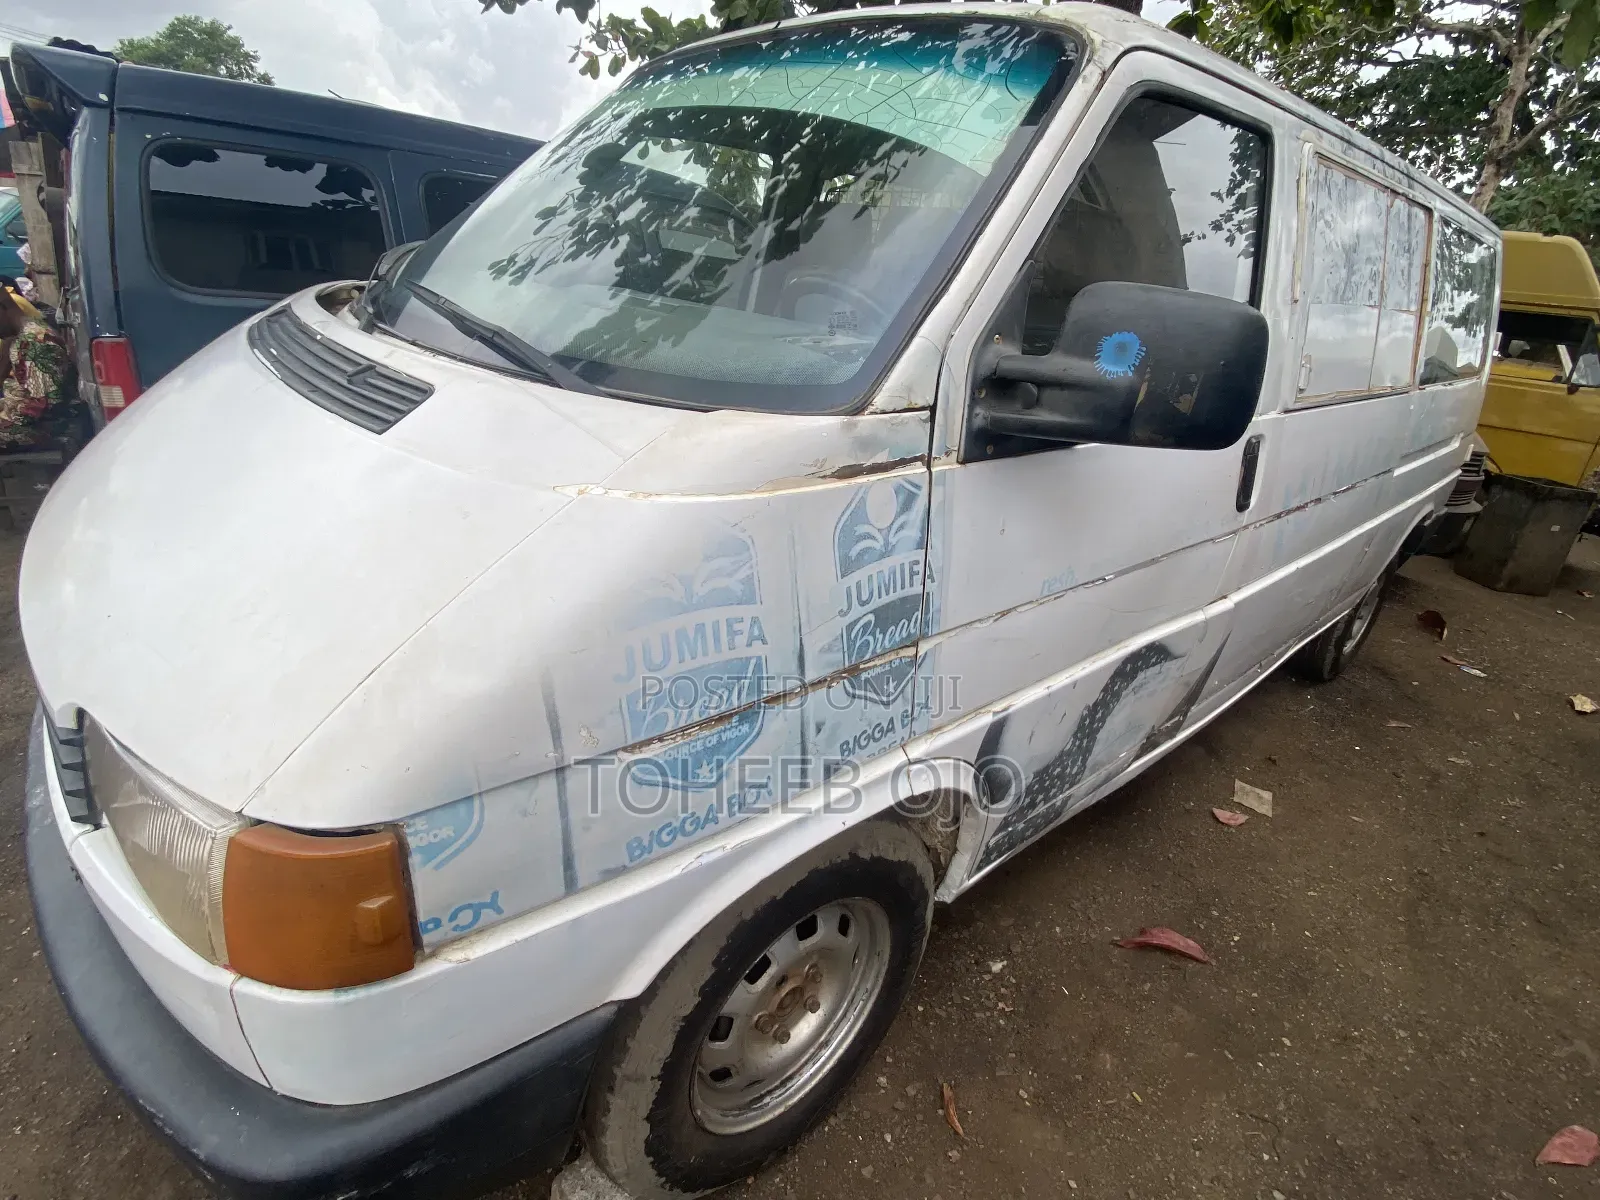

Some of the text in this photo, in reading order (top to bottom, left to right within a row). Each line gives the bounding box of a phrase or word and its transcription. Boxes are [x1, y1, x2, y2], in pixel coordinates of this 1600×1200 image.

[838, 559, 936, 618] JUMIFA
[612, 615, 769, 684] JUMIFA
[850, 612, 932, 664] Bread
[706, 735, 722, 748] OF
[721, 722, 751, 742] VIGOR
[840, 716, 897, 762] BIGGA
[625, 803, 719, 863] BIGGA
